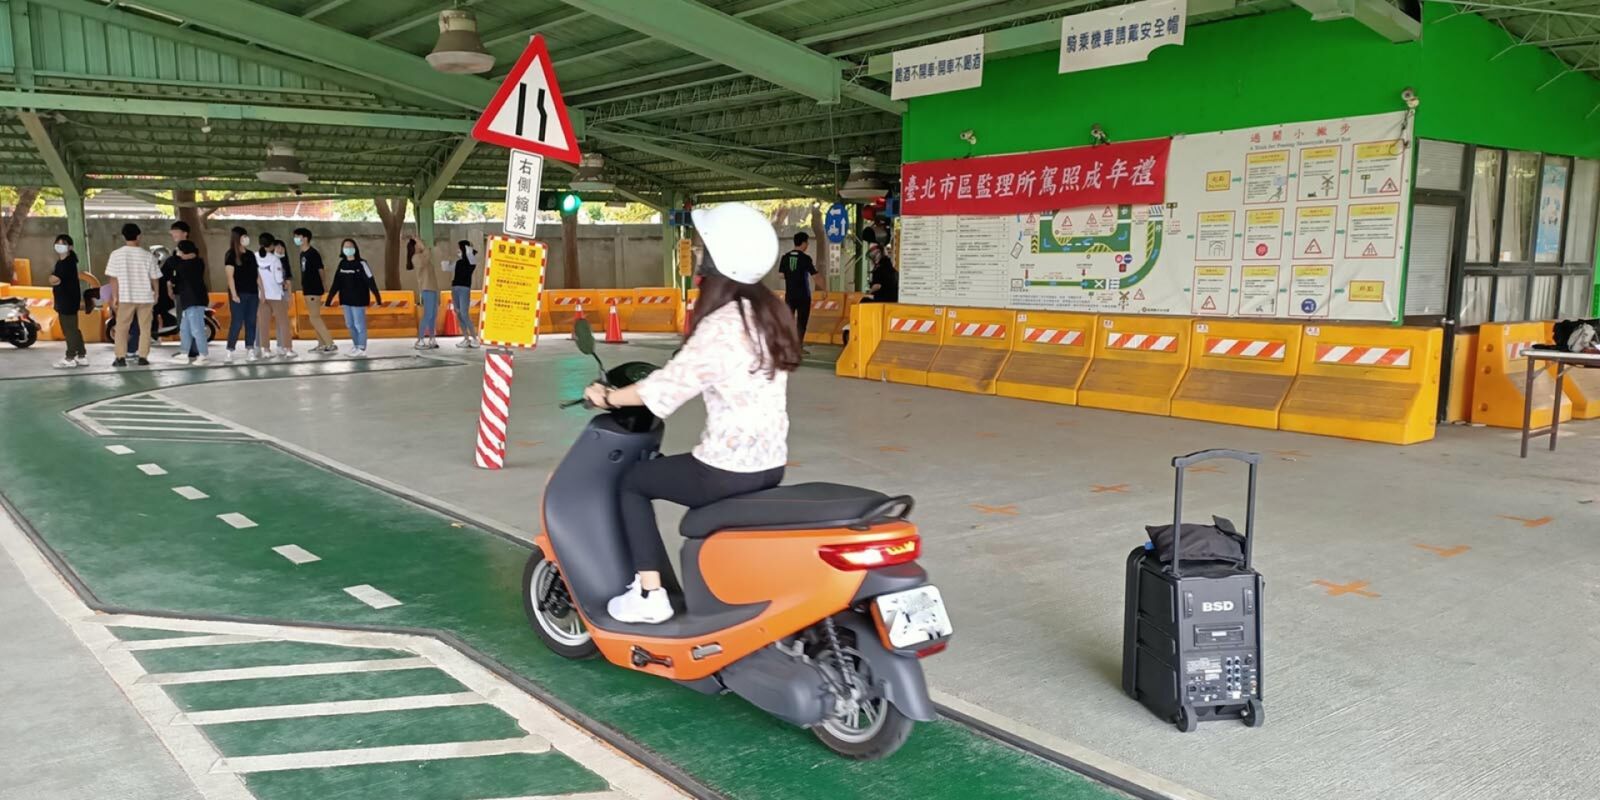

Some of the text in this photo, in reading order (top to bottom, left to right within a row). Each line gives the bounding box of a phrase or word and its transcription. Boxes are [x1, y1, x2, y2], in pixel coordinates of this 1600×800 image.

[1066, 14, 1180, 53] 騎乘機車請戴安全帽
[513, 158, 533, 230] 右側縮減
[904, 155, 1157, 203] 臺北市區監理所駕照成年禮
[1202, 601, 1234, 612] BSD
